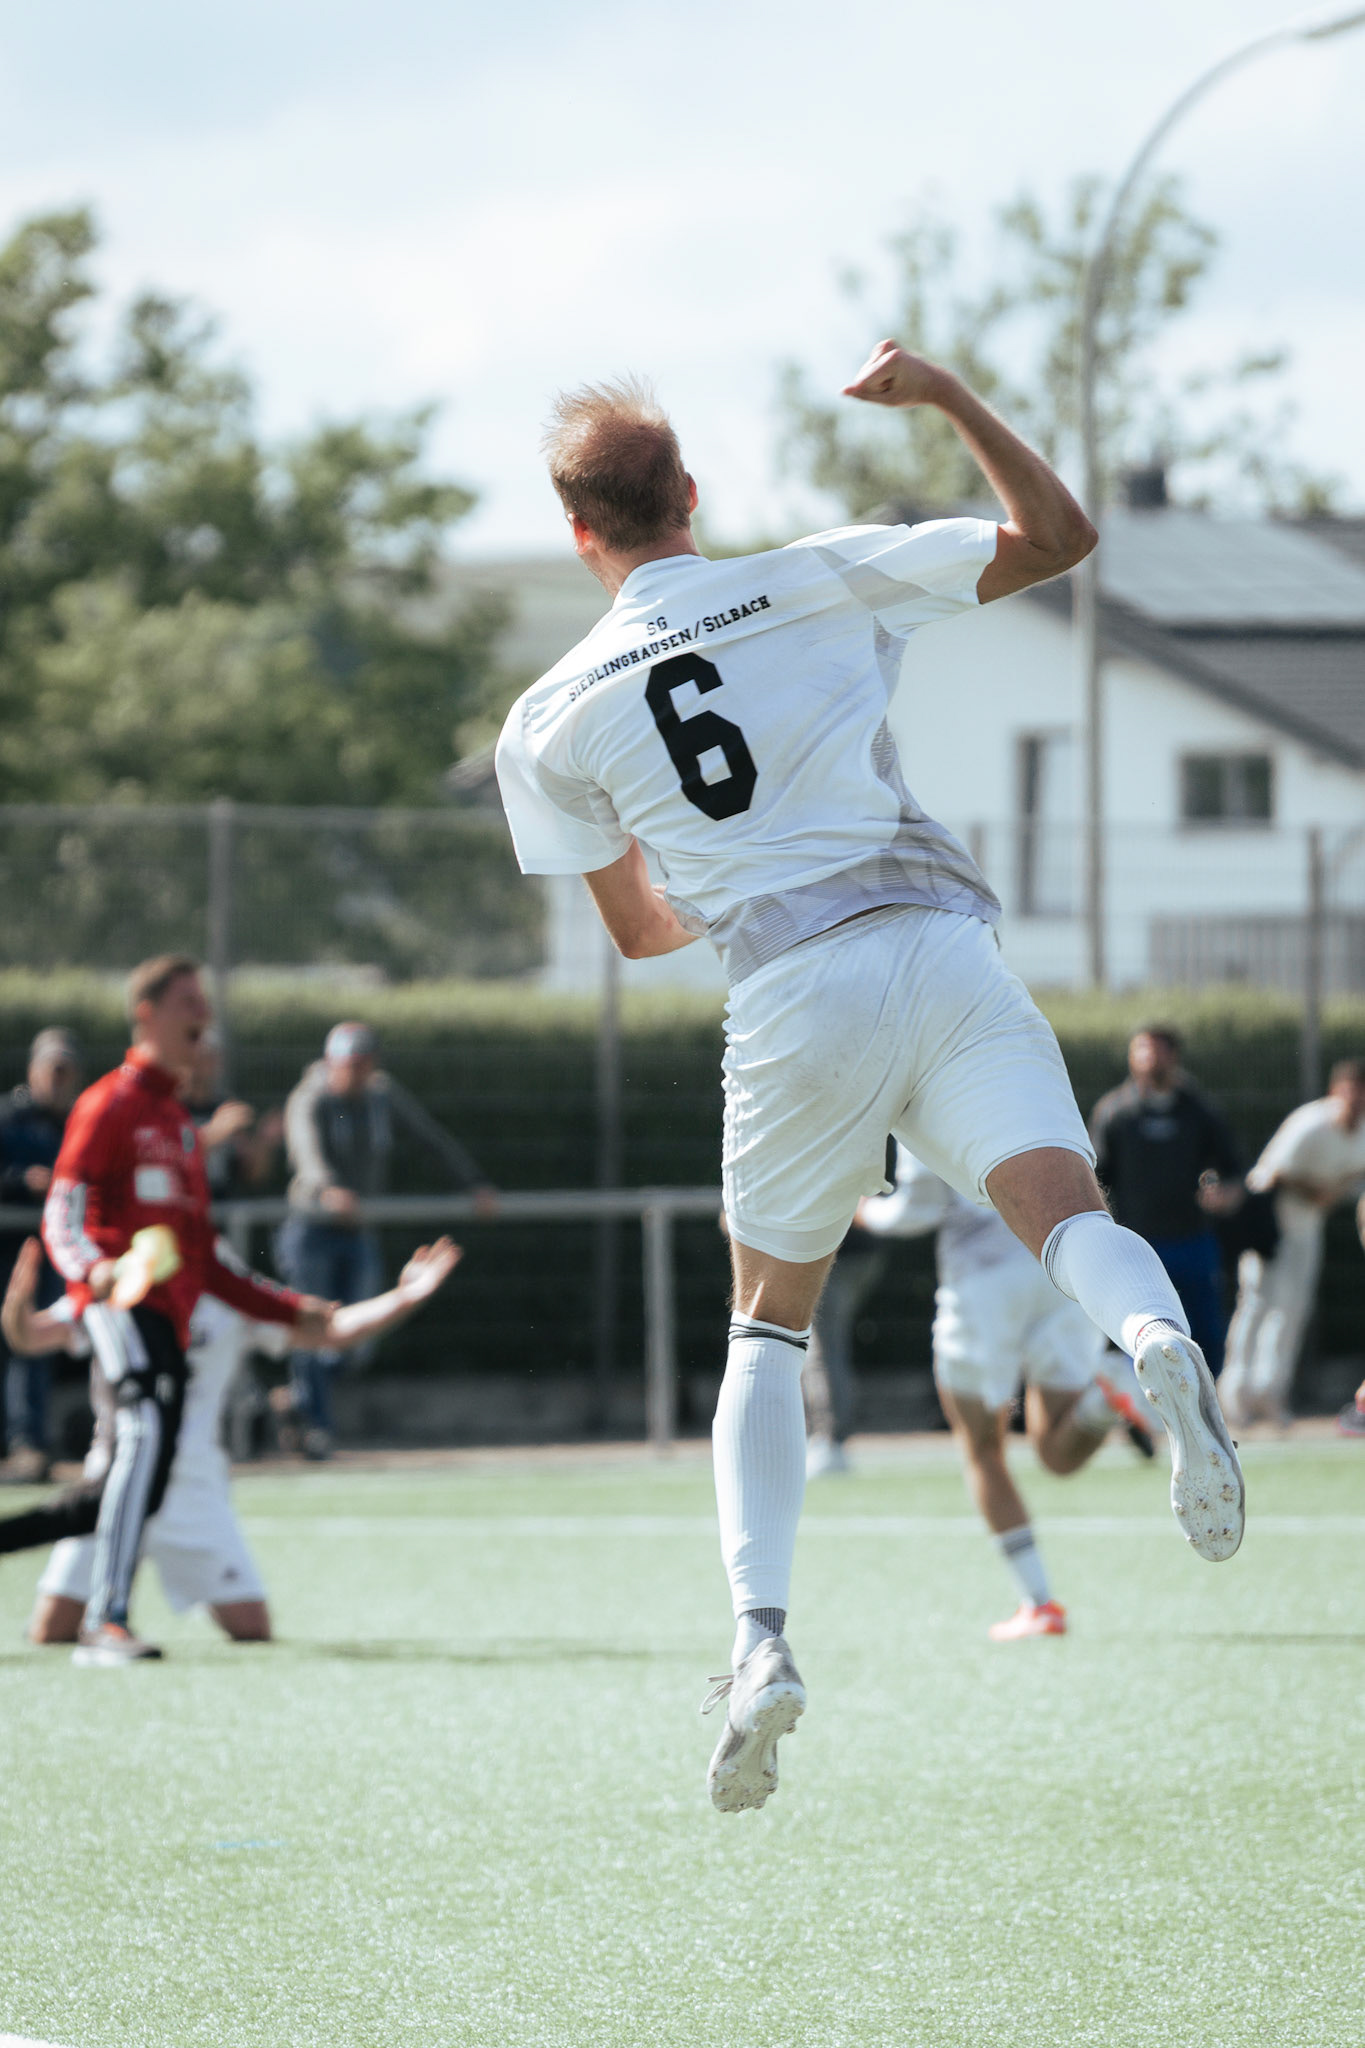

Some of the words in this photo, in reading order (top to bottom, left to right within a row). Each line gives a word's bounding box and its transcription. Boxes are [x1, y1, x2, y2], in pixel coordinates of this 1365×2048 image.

[568, 595, 771, 701] SIEDLINGHAUSEN/SILBACH
[647, 616, 668, 635] SG
[645, 652, 758, 821] 6
